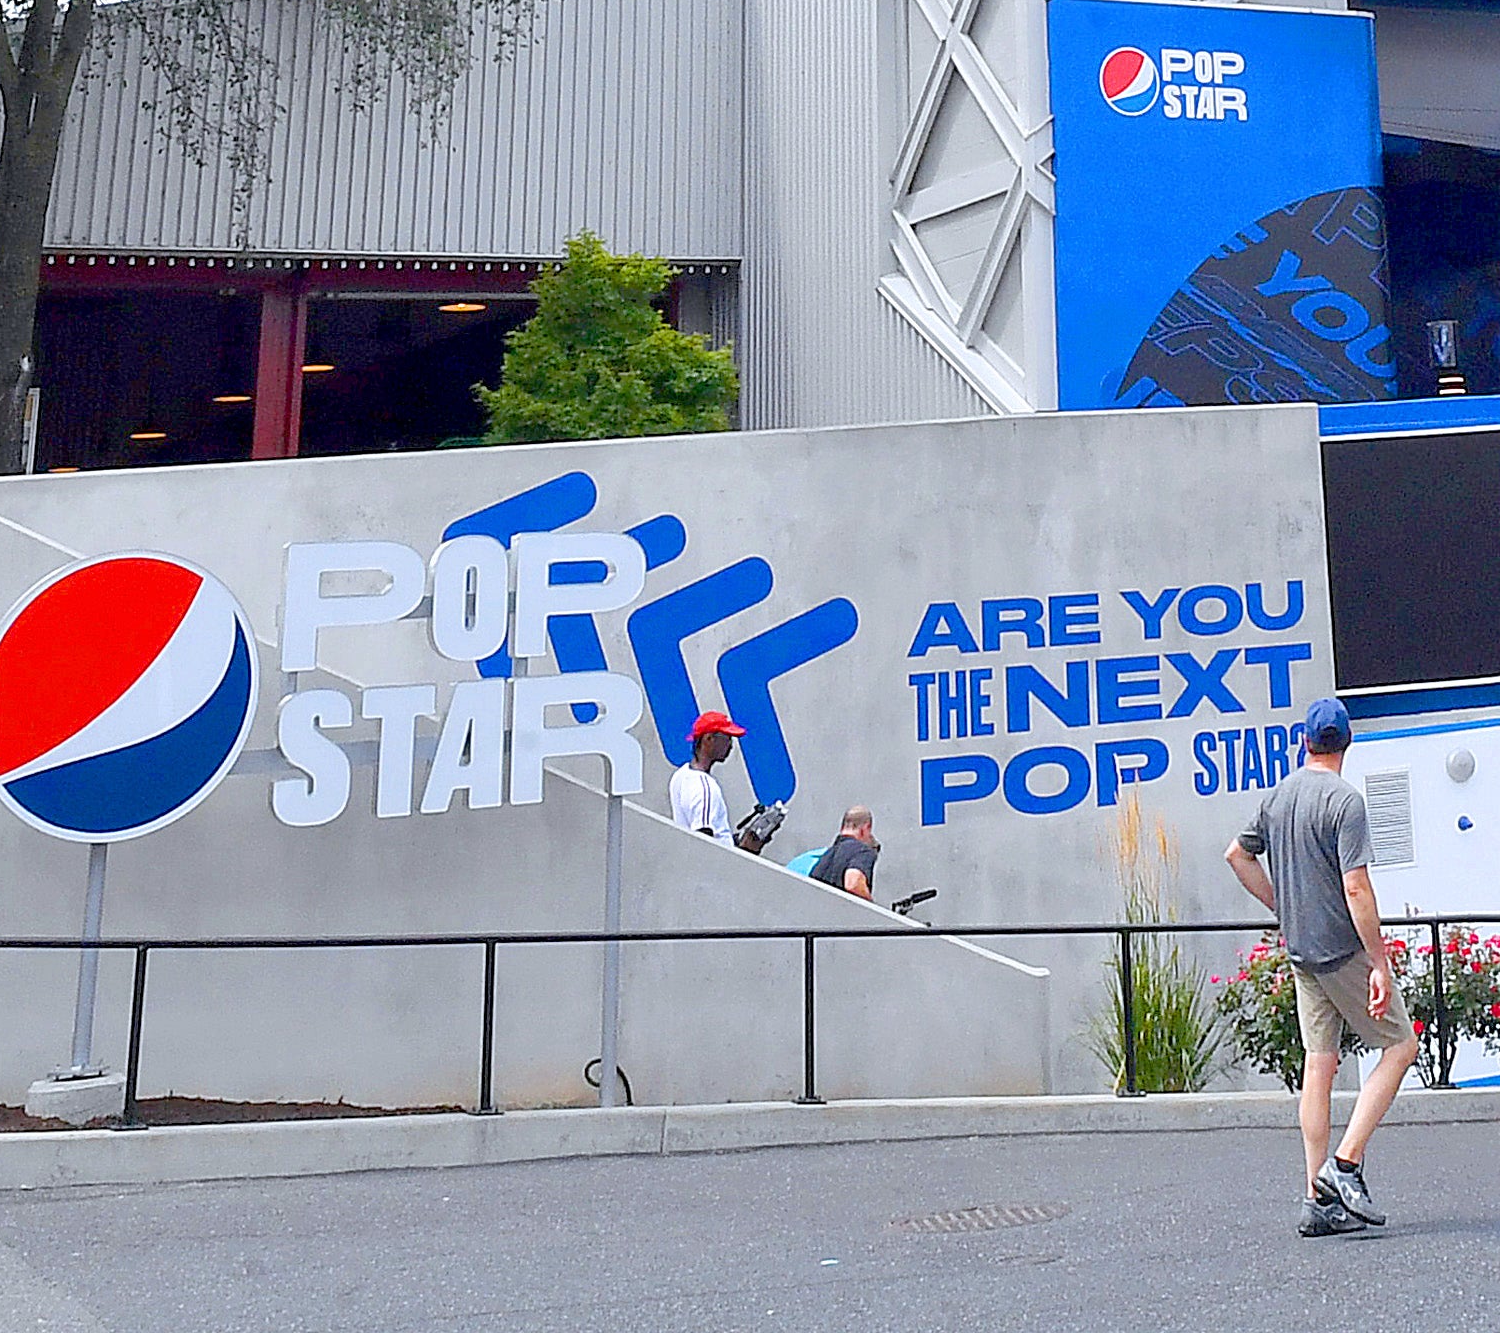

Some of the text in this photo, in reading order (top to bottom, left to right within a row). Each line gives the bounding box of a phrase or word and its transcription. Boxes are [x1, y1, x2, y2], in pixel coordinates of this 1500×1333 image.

[1161, 48, 1246, 84] POP
[1164, 85, 1248, 121] STAR
[281, 532, 647, 673] POP
[908, 580, 1305, 658] ARE YOU
[909, 643, 1312, 742] THE NEXT
[273, 670, 644, 827] STAR
[920, 738, 1169, 827] POP
